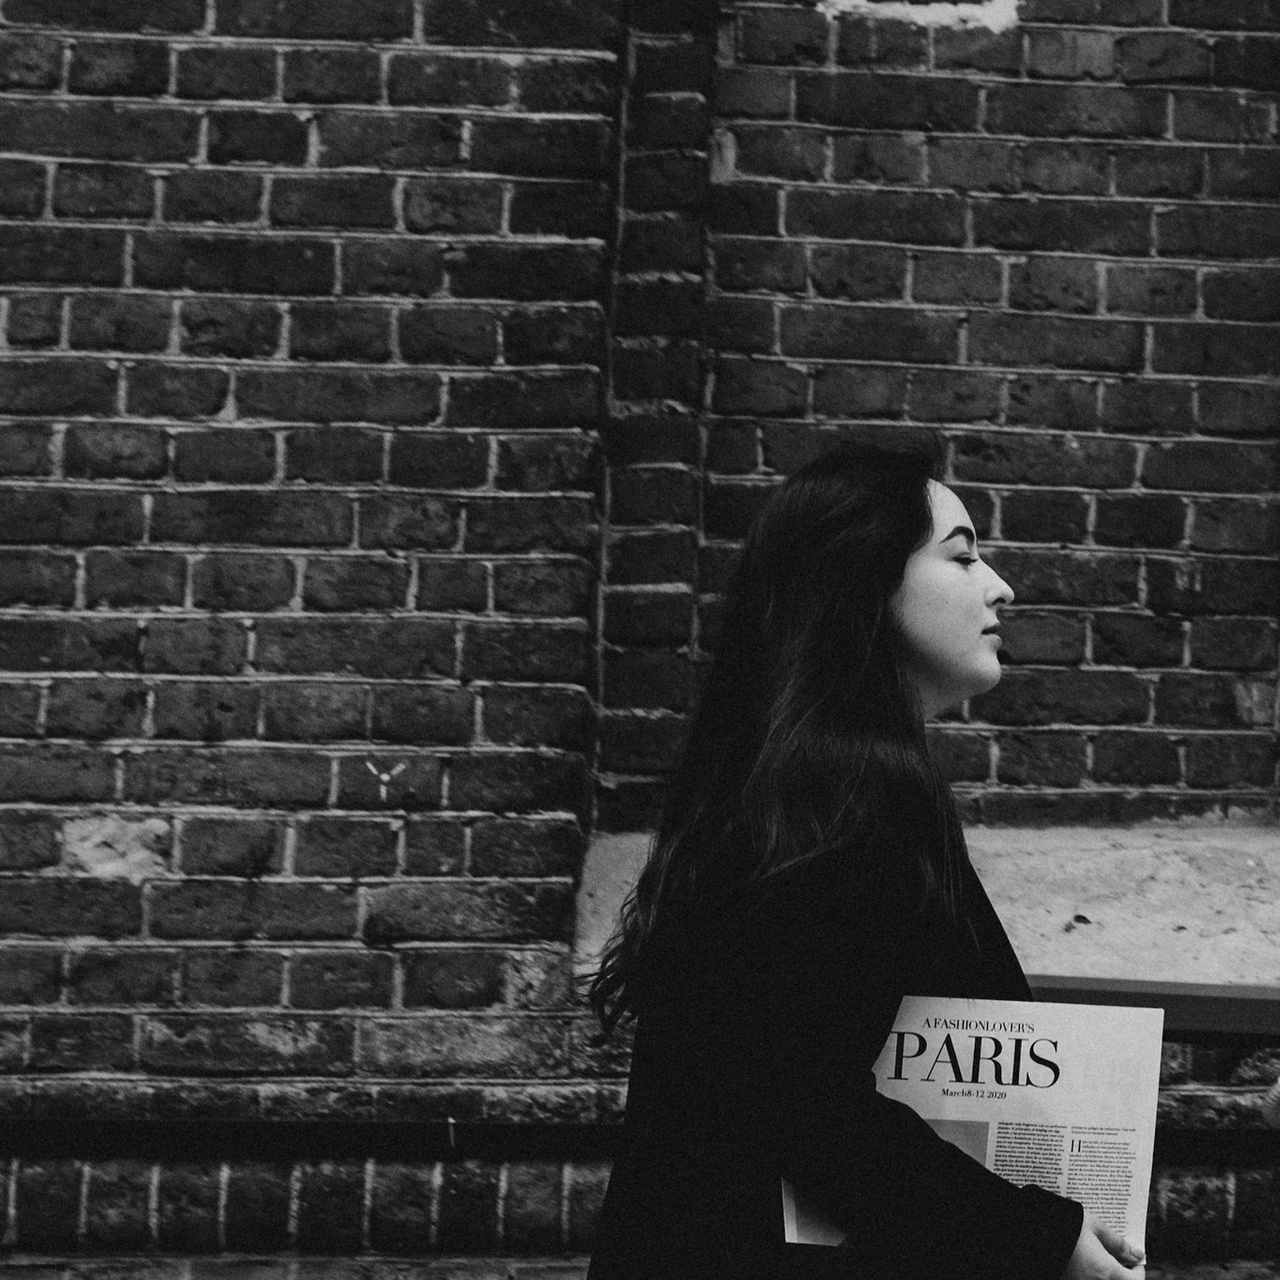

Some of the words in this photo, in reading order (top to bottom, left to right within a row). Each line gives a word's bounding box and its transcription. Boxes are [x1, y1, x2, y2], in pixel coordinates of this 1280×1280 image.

[922, 1017, 932, 1029] A
[887, 1031, 1060, 1088] PARIS
[986, 1090, 1007, 1100] 2020
